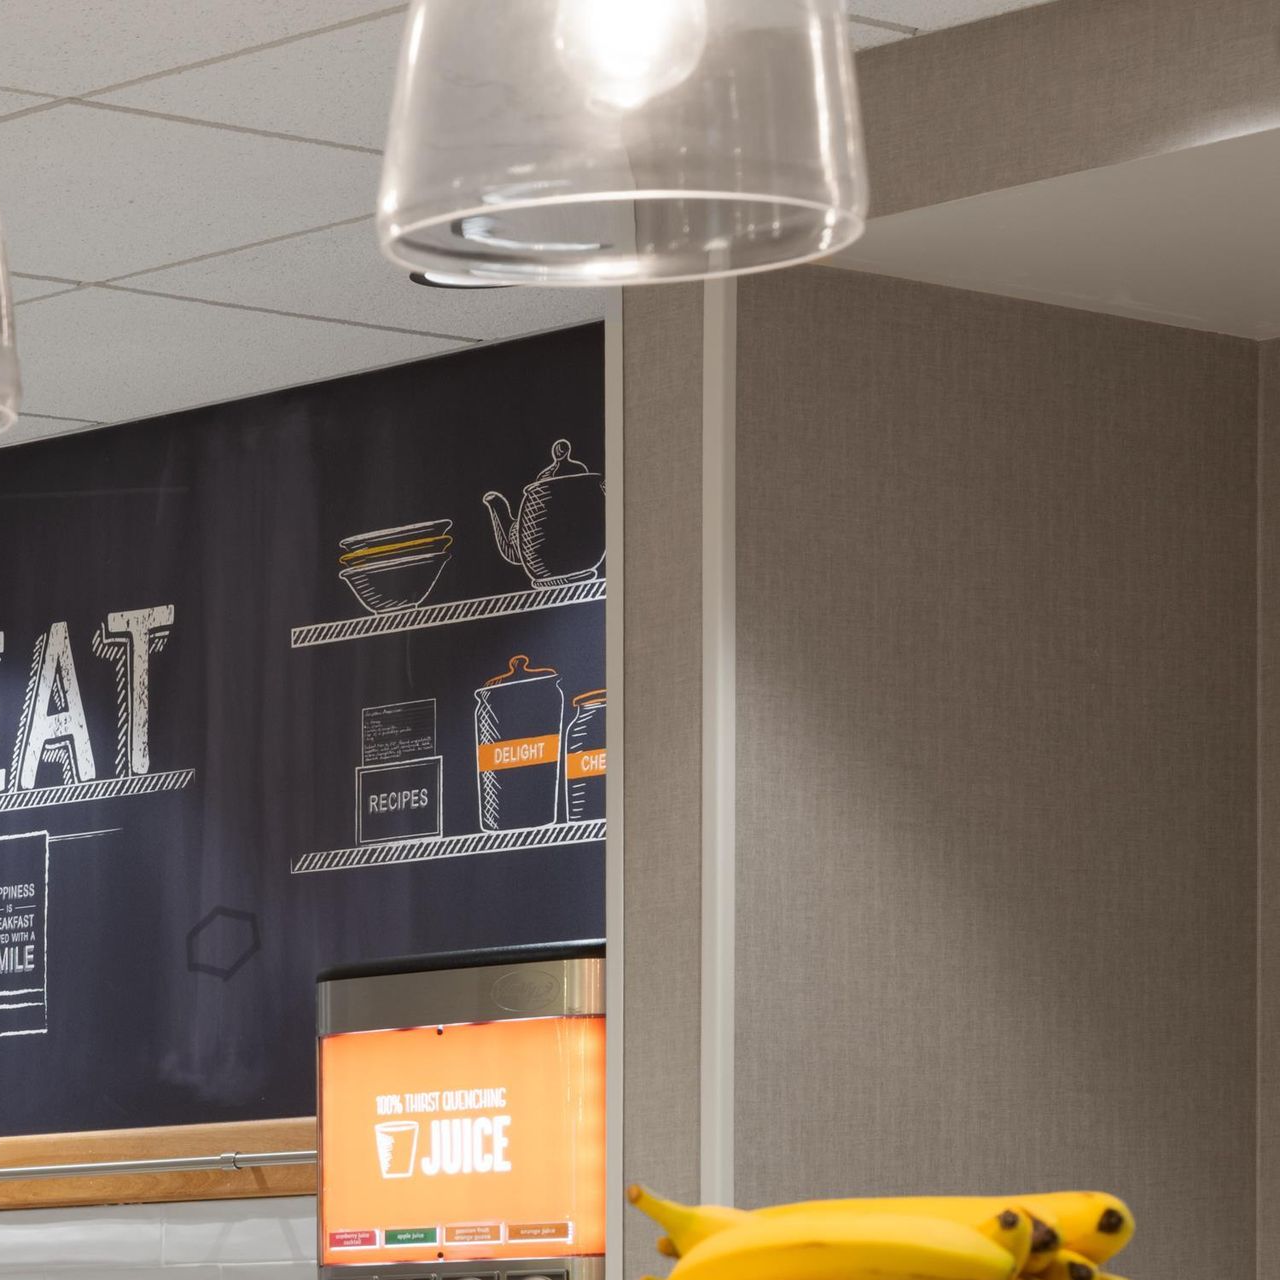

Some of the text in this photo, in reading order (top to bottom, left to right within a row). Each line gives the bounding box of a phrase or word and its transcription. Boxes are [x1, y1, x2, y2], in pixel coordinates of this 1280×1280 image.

[494, 742, 545, 763] DELIGHT
[369, 788, 429, 815] RECIPES
[6, 904, 13, 914] IS
[11, 931, 29, 942] WITH
[30, 930, 36, 941] A
[376, 1087, 506, 1115] 100% THIRST QUENCHING
[421, 1115, 512, 1176] JUICE
